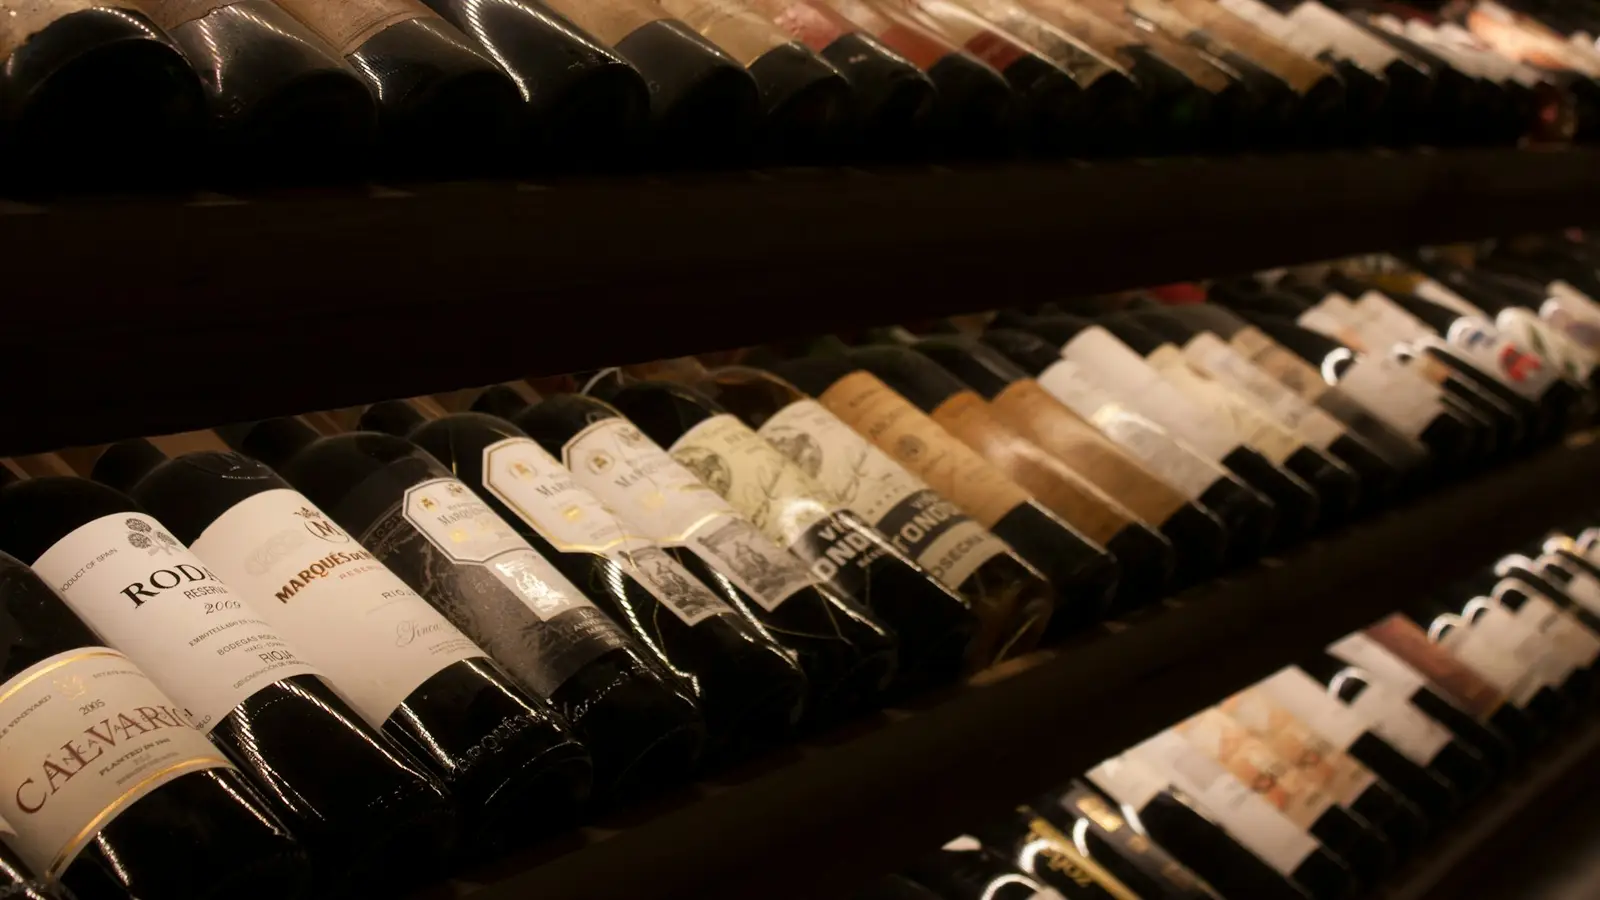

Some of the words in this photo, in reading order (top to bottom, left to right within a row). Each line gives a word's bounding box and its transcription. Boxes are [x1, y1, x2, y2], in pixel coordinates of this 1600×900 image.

[86, 560, 97, 570] OF
[97, 547, 118, 564] SPAIN
[931, 533, 984, 578] OSECHA
[120, 563, 225, 609] RODA
[274, 552, 352, 604] MARQUÉS
[204, 600, 242, 615] 2009
[188, 620, 238, 647] EMBOTELLADO
[217, 634, 259, 656] BODEGAS
[258, 649, 297, 664] RIOJA
[8, 694, 52, 728] VINEYARD
[79, 699, 106, 716] 2005
[99, 747, 143, 776] PLANTED
